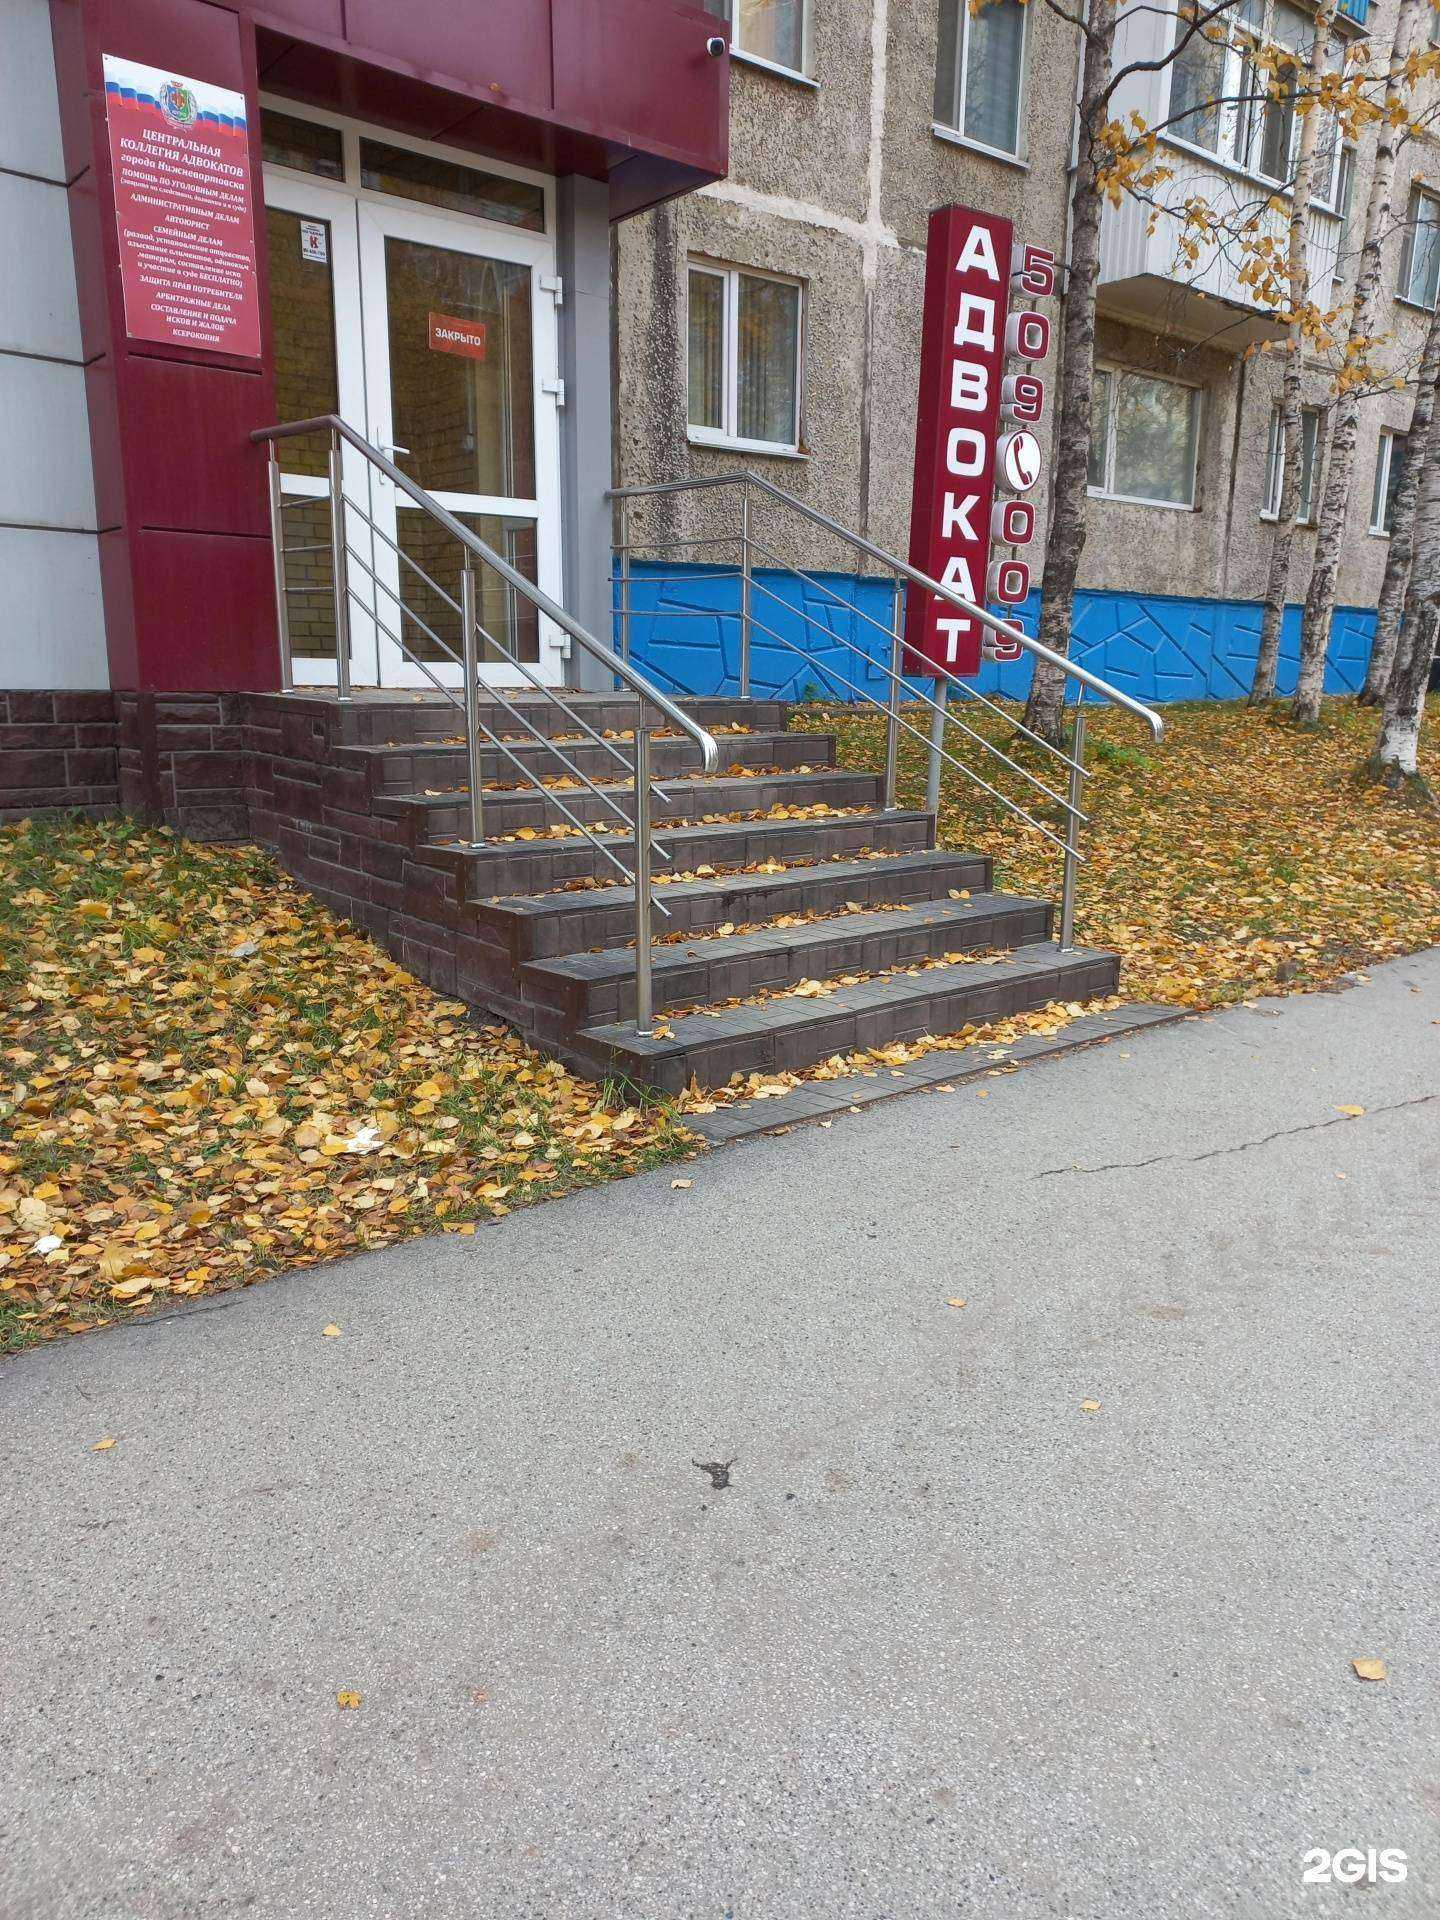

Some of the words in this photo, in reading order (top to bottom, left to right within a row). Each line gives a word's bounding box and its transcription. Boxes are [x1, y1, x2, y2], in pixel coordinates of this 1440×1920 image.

[142, 128, 221, 158] ЦЕНТРАЛЬНАЯ
[120, 137, 180, 160] КОЛЛЕГИЯ
[181, 153, 244, 177] АДВОКАТОВ
[120, 153, 156, 169] города
[157, 160, 245, 191] Нижневартовска
[121, 167, 158, 183] ПОМОЩЬ
[159, 176, 171, 186] ПО
[171, 178, 219, 197] УГОЛОВНЫМ
[218, 191, 244, 204] ДЕЛАМ
[130, 192, 214, 218] АДМИНИСТРАТИВНЫМ
[214, 211, 240, 225] ДЕЛАМ
[164, 213, 211, 231] АВТОЮРИСТ
[231, 203, 247, 214] суде)
[123, 228, 155, 242] (развод,
[155, 236, 209, 253] установление
[209, 247, 251, 263] отцовство,
[153, 225, 197, 241] СЕМЕЙНЫМ
[197, 235, 223, 247] ДЕЛАМ
[127, 240, 168, 254] взыскание
[168, 248, 214, 264] алиментов,
[214, 257, 250, 271] одиноким
[137, 252, 177, 265] матерям,
[177, 259, 224, 274] составление
[225, 268, 241, 279] иска
[138, 274, 172, 288] ЗАЩИТА
[172, 280, 192, 291] ПРАВ
[192, 284, 243, 301] ПОТРЕБИТЕЛЯ
[142, 261, 176, 275] участие
[182, 269, 199, 280] суде
[198, 272, 243, 288] БЕСПЛАТНО)
[150, 303, 202, 319] СОСТАВЛЕНИЕ
[203, 311, 210, 320] И
[210, 312, 237, 325] ПОДАЧА
[155, 291, 212, 308] АРБИТРАЖНЫЕ
[212, 302, 231, 312] ДЕЛА
[166, 315, 192, 325] ИСКОВ
[191, 319, 198, 327] И
[198, 320, 225, 332] ЖАЛОБ
[435, 327, 481, 346] ЗАКРЫТО
[934, 225, 1000, 662] АДВОКАТ
